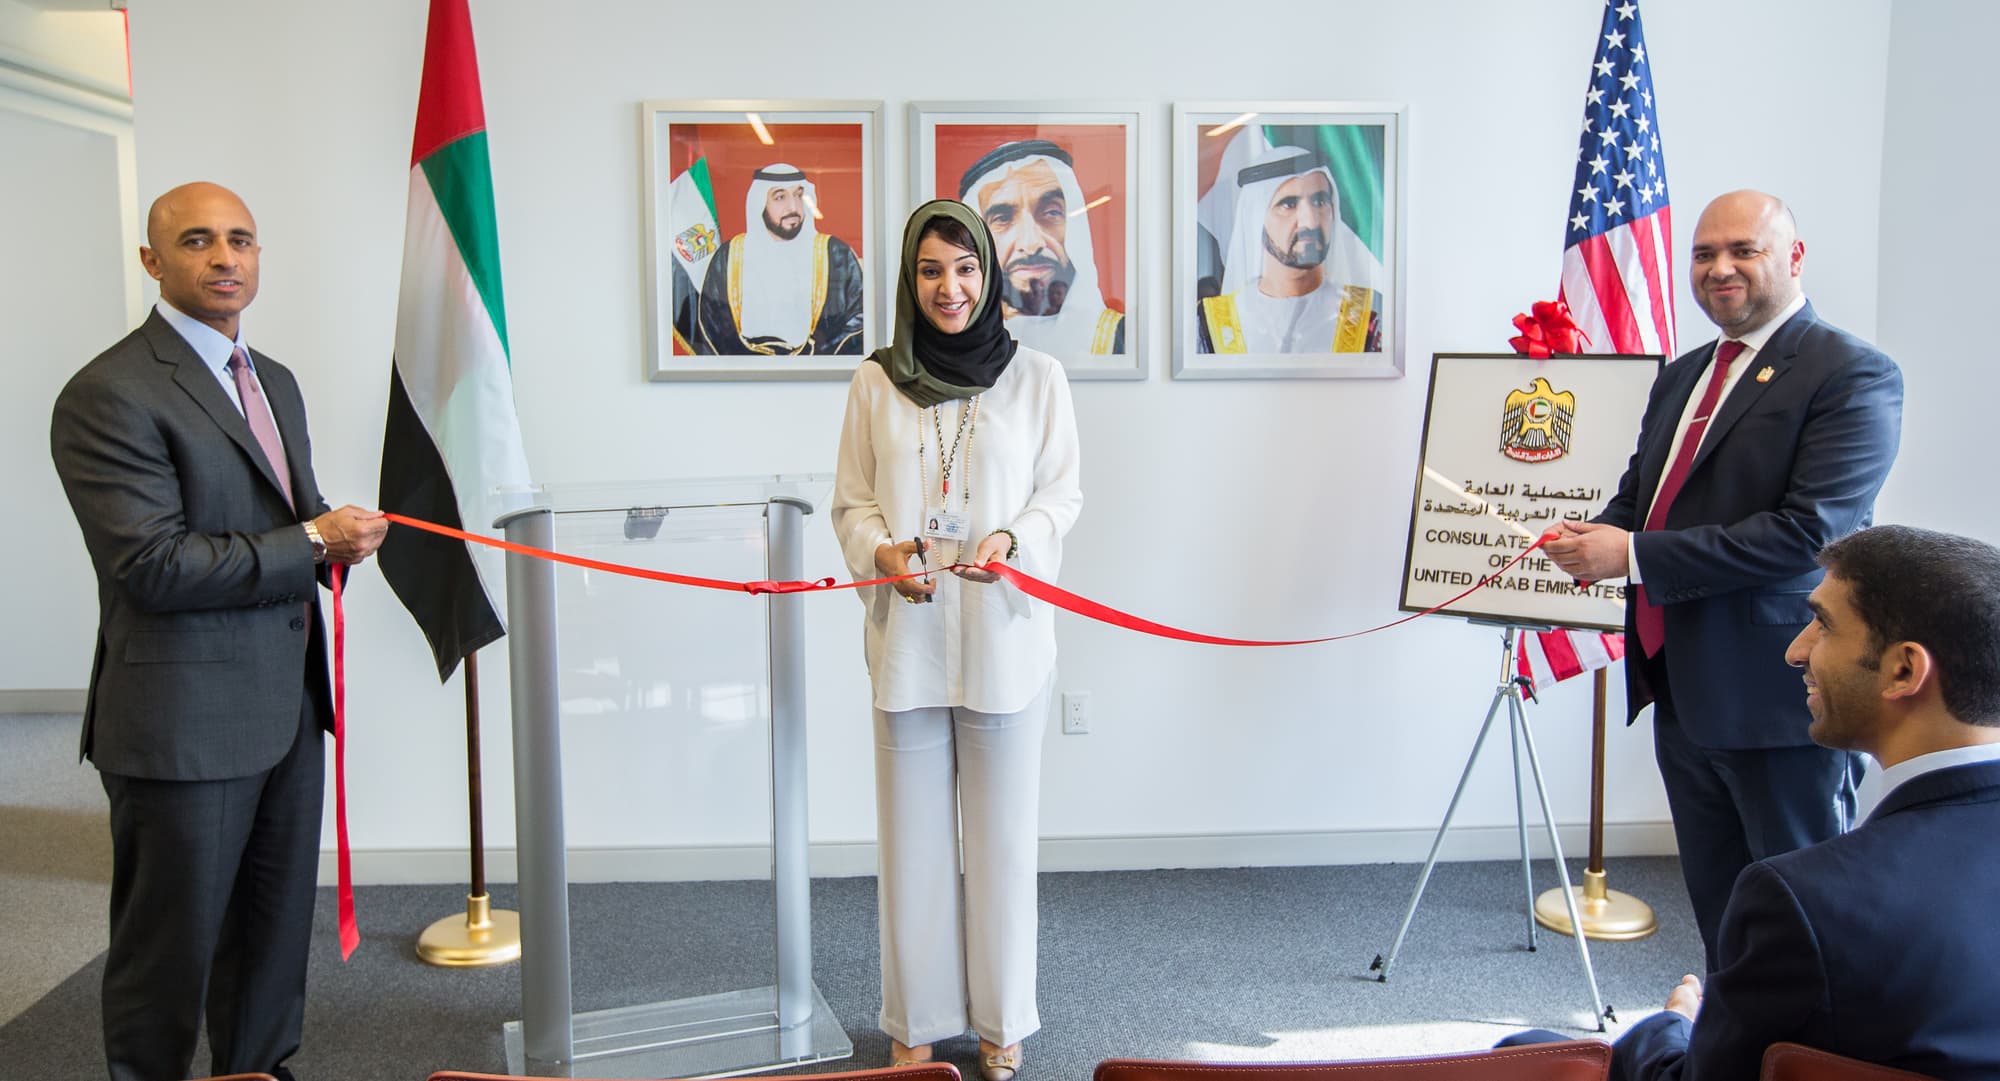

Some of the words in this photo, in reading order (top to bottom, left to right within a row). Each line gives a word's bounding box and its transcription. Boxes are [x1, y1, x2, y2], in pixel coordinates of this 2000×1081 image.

[1464, 480, 1514, 496] العامة
[1521, 484, 1601, 502] القنصلية
[1423, 499, 1489, 517] المتحدة
[1496, 503, 1556, 522] العربية
[1425, 529, 1531, 549] CONSULATE
[1488, 554, 1512, 568] OF
[1520, 556, 1552, 572] THE
[1414, 567, 1472, 586] UNITED
[1478, 574, 1530, 591] ARAB
